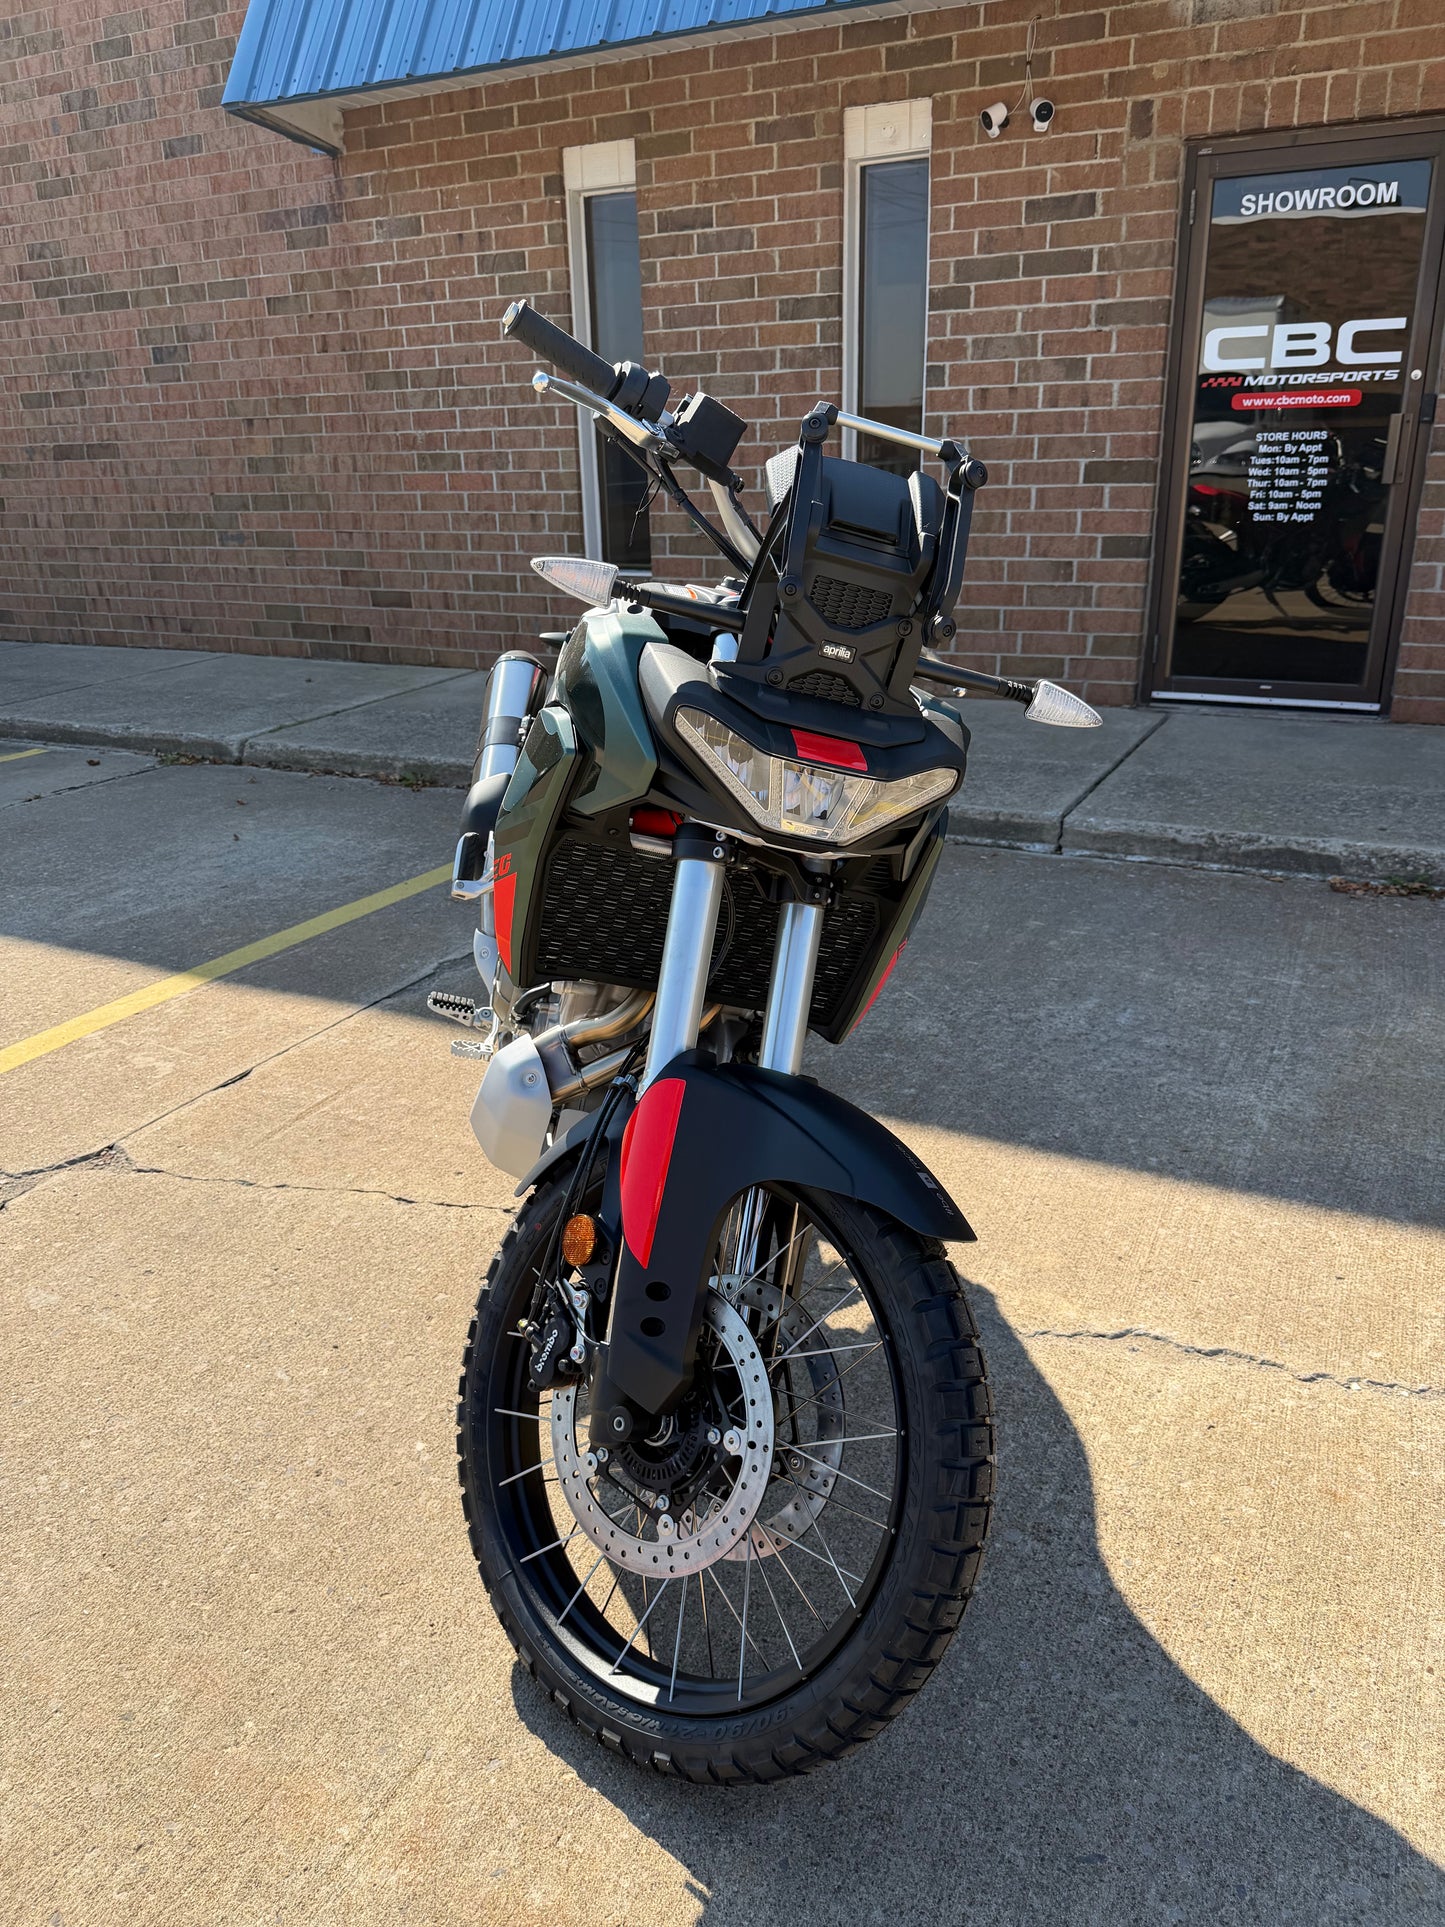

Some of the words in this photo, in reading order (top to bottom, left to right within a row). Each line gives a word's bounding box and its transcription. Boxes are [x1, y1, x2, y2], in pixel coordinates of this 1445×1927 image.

[1240, 181, 1399, 217] SHOWROOM
[1203, 317, 1407, 370] CBC
[1244, 369, 1400, 387] MOTORSPORTS
[1242, 394, 1350, 406] www.cbcmoto.com
[1256, 432, 1289, 441] STORE
[1292, 431, 1328, 440] HOURS
[1259, 444, 1282, 453] Mon:
[1284, 444, 1297, 454] By
[1299, 443, 1322, 453] Appt
[1308, 455, 1329, 464] 7pm
[1248, 468, 1271, 476] Wed:
[1274, 467, 1299, 475] 10am
[1307, 467, 1328, 476] 5pm
[1248, 479, 1271, 487] Thur:
[1307, 478, 1327, 488] 7pm
[1250, 490, 1266, 498] Fri:
[1268, 490, 1293, 498] 10am
[1301, 490, 1322, 499] 5pm
[1248, 502, 1266, 510] Sat:
[1268, 502, 1288, 510] 9am
[1296, 501, 1321, 509] Noon
[1253, 513, 1274, 521] Sun:
[1277, 513, 1289, 522] By
[1291, 513, 1314, 522] Appt
[823, 645, 851, 659] aprilia
[535, 1330, 558, 1372] brembo
